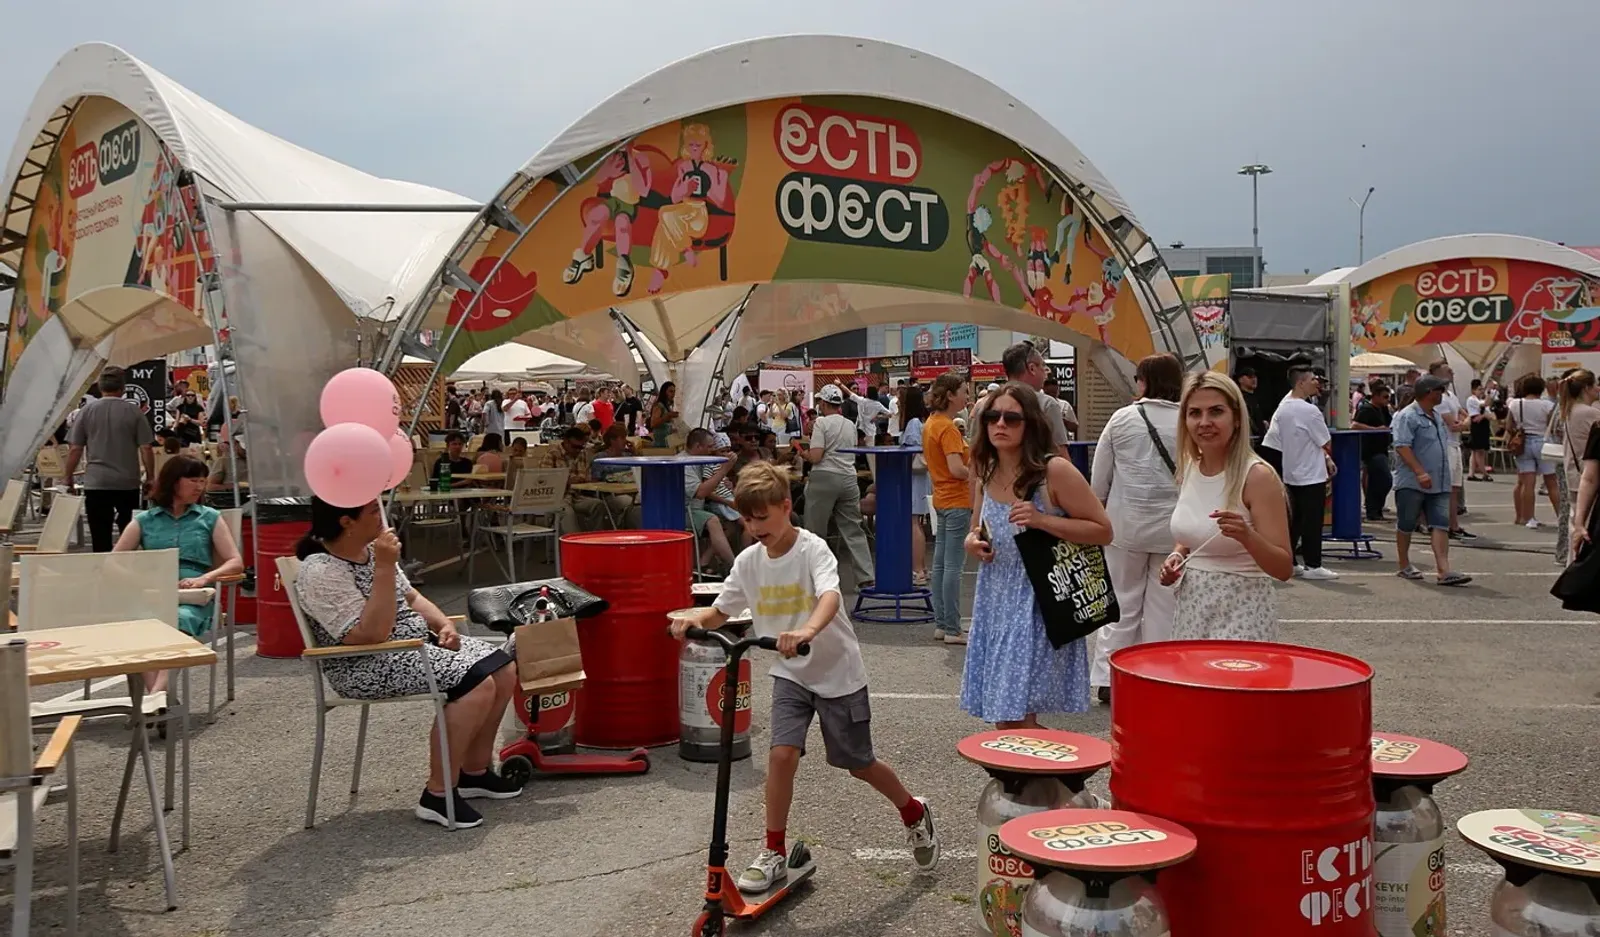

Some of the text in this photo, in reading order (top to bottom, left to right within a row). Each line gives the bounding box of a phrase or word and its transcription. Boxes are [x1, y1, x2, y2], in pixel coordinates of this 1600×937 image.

[780, 108, 918, 178] ЕСТЬ
[69, 126, 138, 191] ЕСТЬ ФЕСТ
[780, 177, 938, 244] ФЕСТ
[1417, 268, 1496, 296] ЕСТЬ
[1416, 296, 1508, 324] ФЕСТ
[916, 333, 929, 344] 15
[132, 369, 153, 379] MY
[154, 400, 164, 432] BLOG
[522, 486, 555, 498] AMSTEL
[1064, 551, 1090, 574] ASK
[1031, 823, 1127, 839] ЕСТЬ
[1047, 830, 1155, 849] ФЕСТ
[989, 855, 1035, 876] ФЕС
[1301, 836, 1372, 884] ЕСТЬ
[1300, 874, 1373, 926] ФЕСТ
